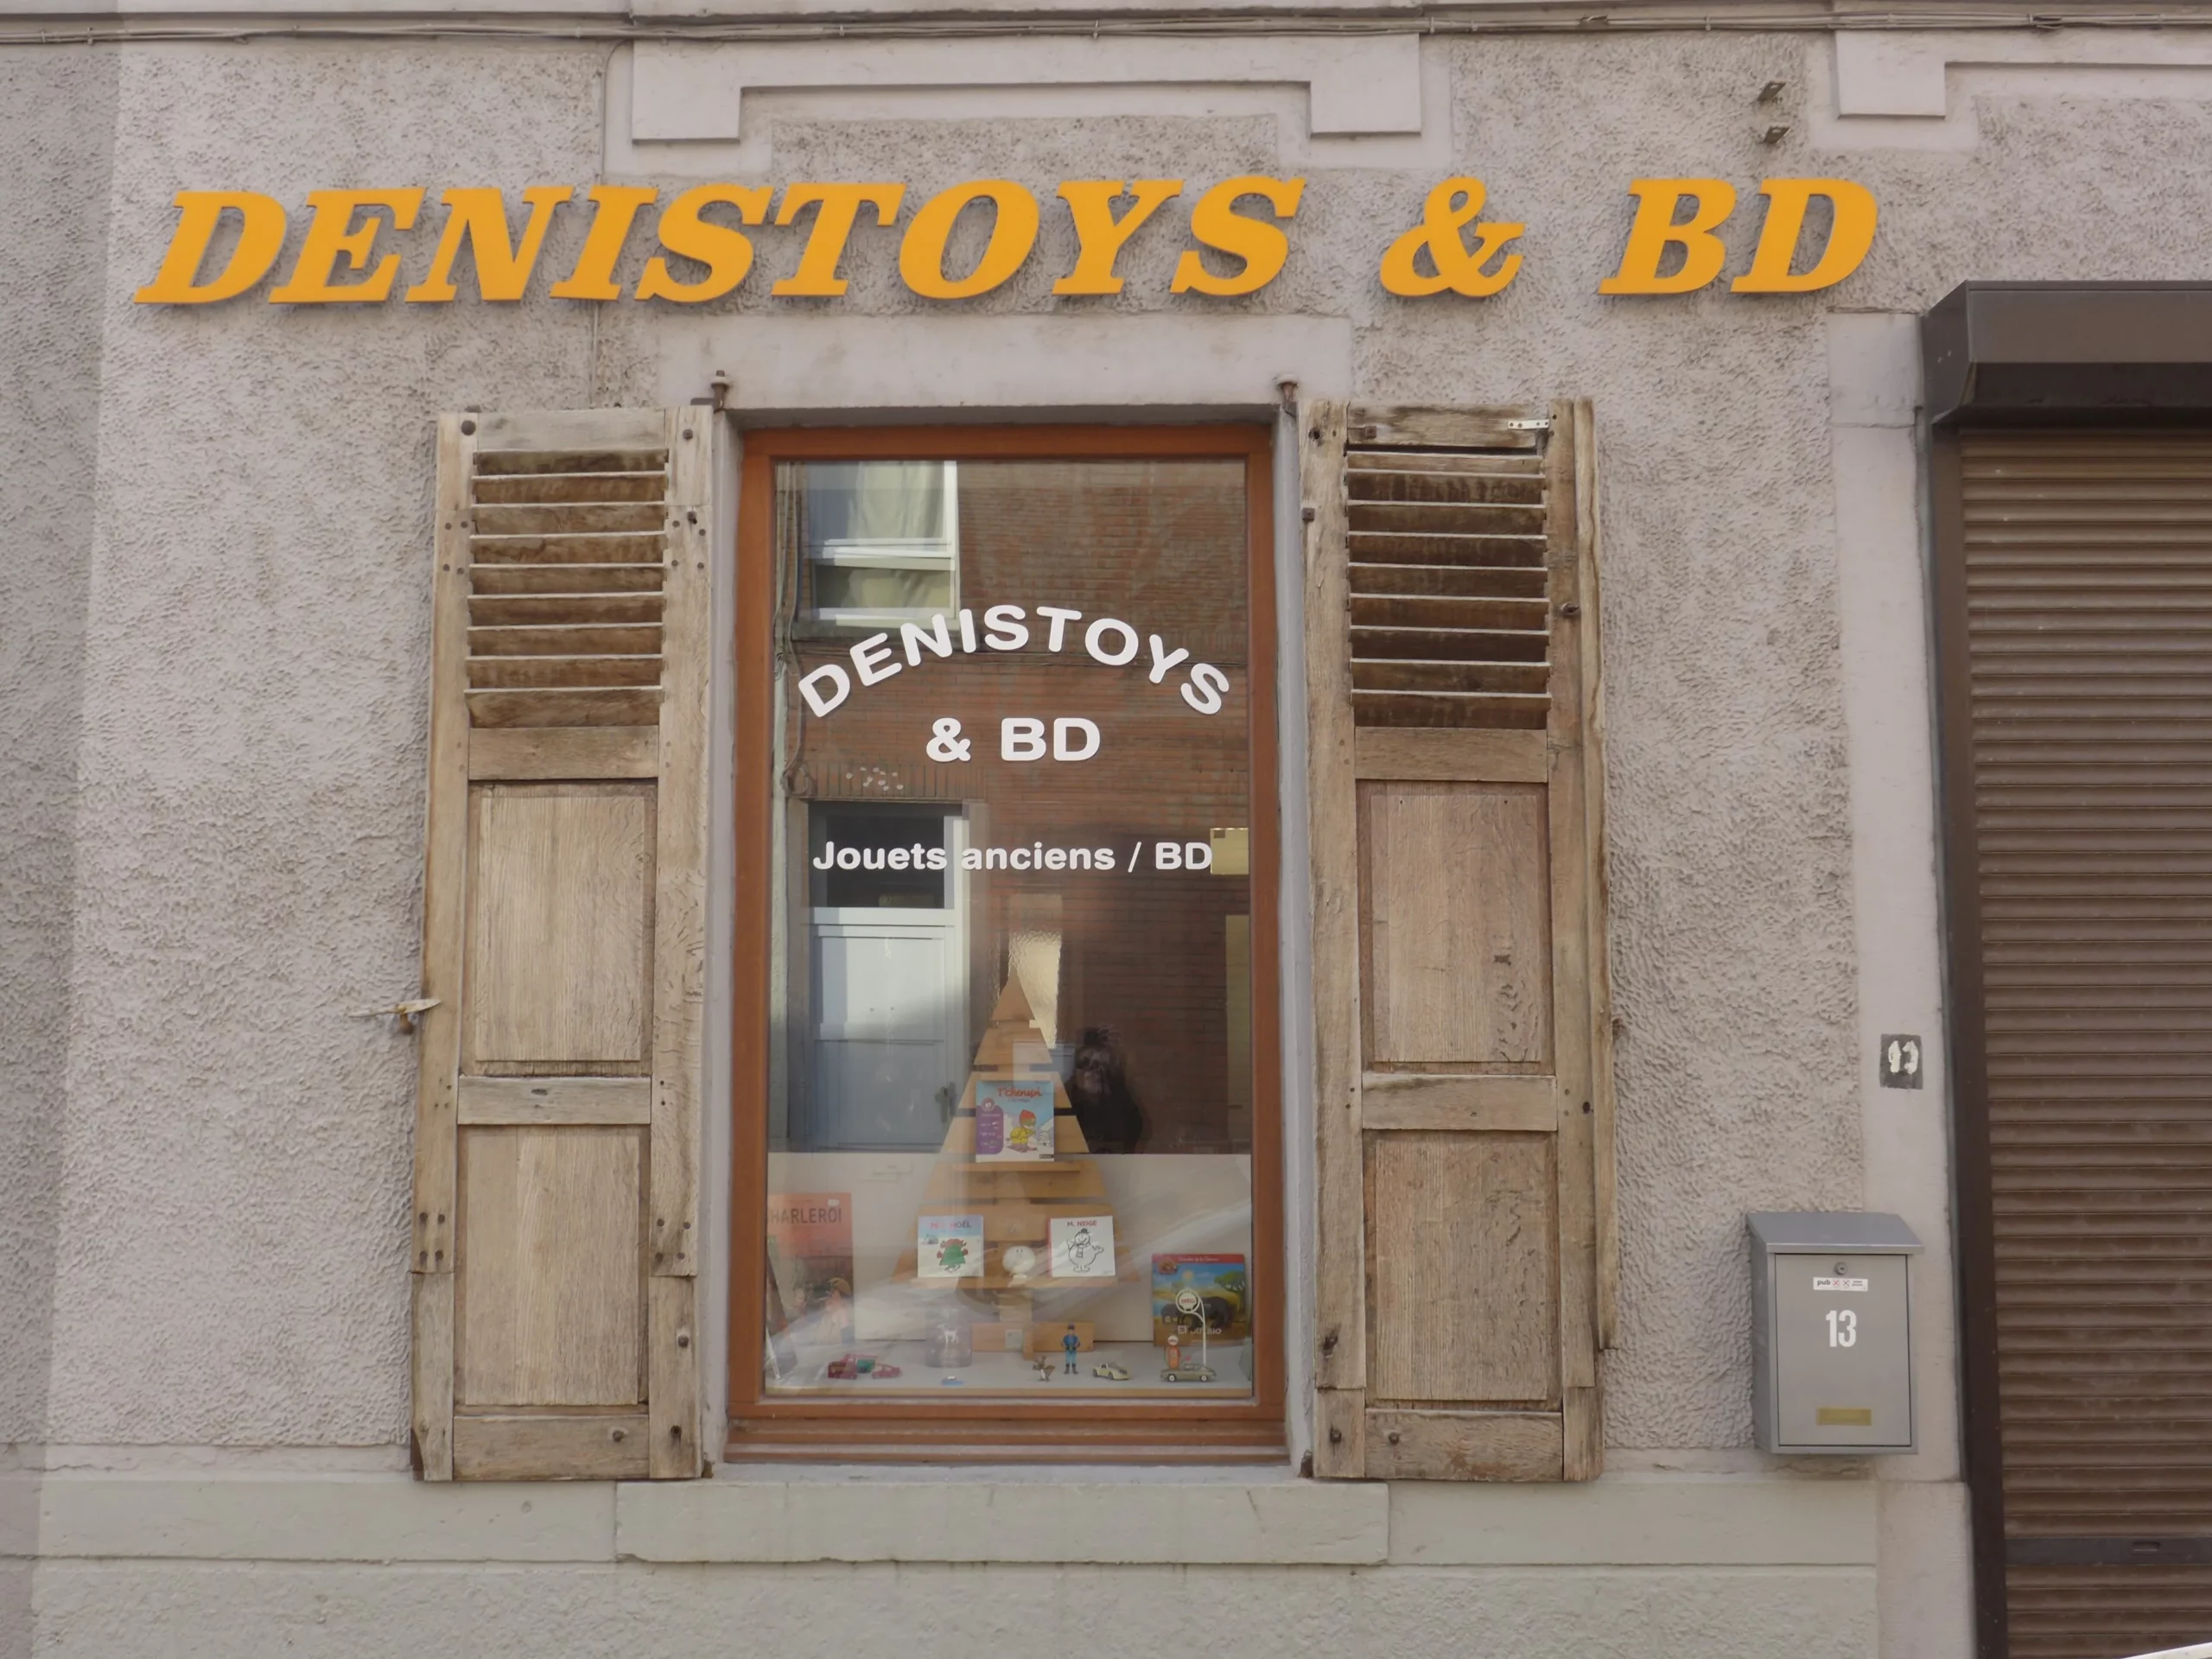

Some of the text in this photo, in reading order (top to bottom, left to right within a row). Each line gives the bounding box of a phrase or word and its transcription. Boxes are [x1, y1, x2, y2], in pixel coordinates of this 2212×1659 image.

[135, 175, 1878, 304] DENISTOYS & BD
[798, 604, 1230, 718] DENISTOYS
[925, 717, 1101, 763] & BD
[812, 841, 1212, 874] Jouets anciens / BD
[1887, 1039, 1919, 1075] 13
[1825, 1309, 1857, 1347] 13
